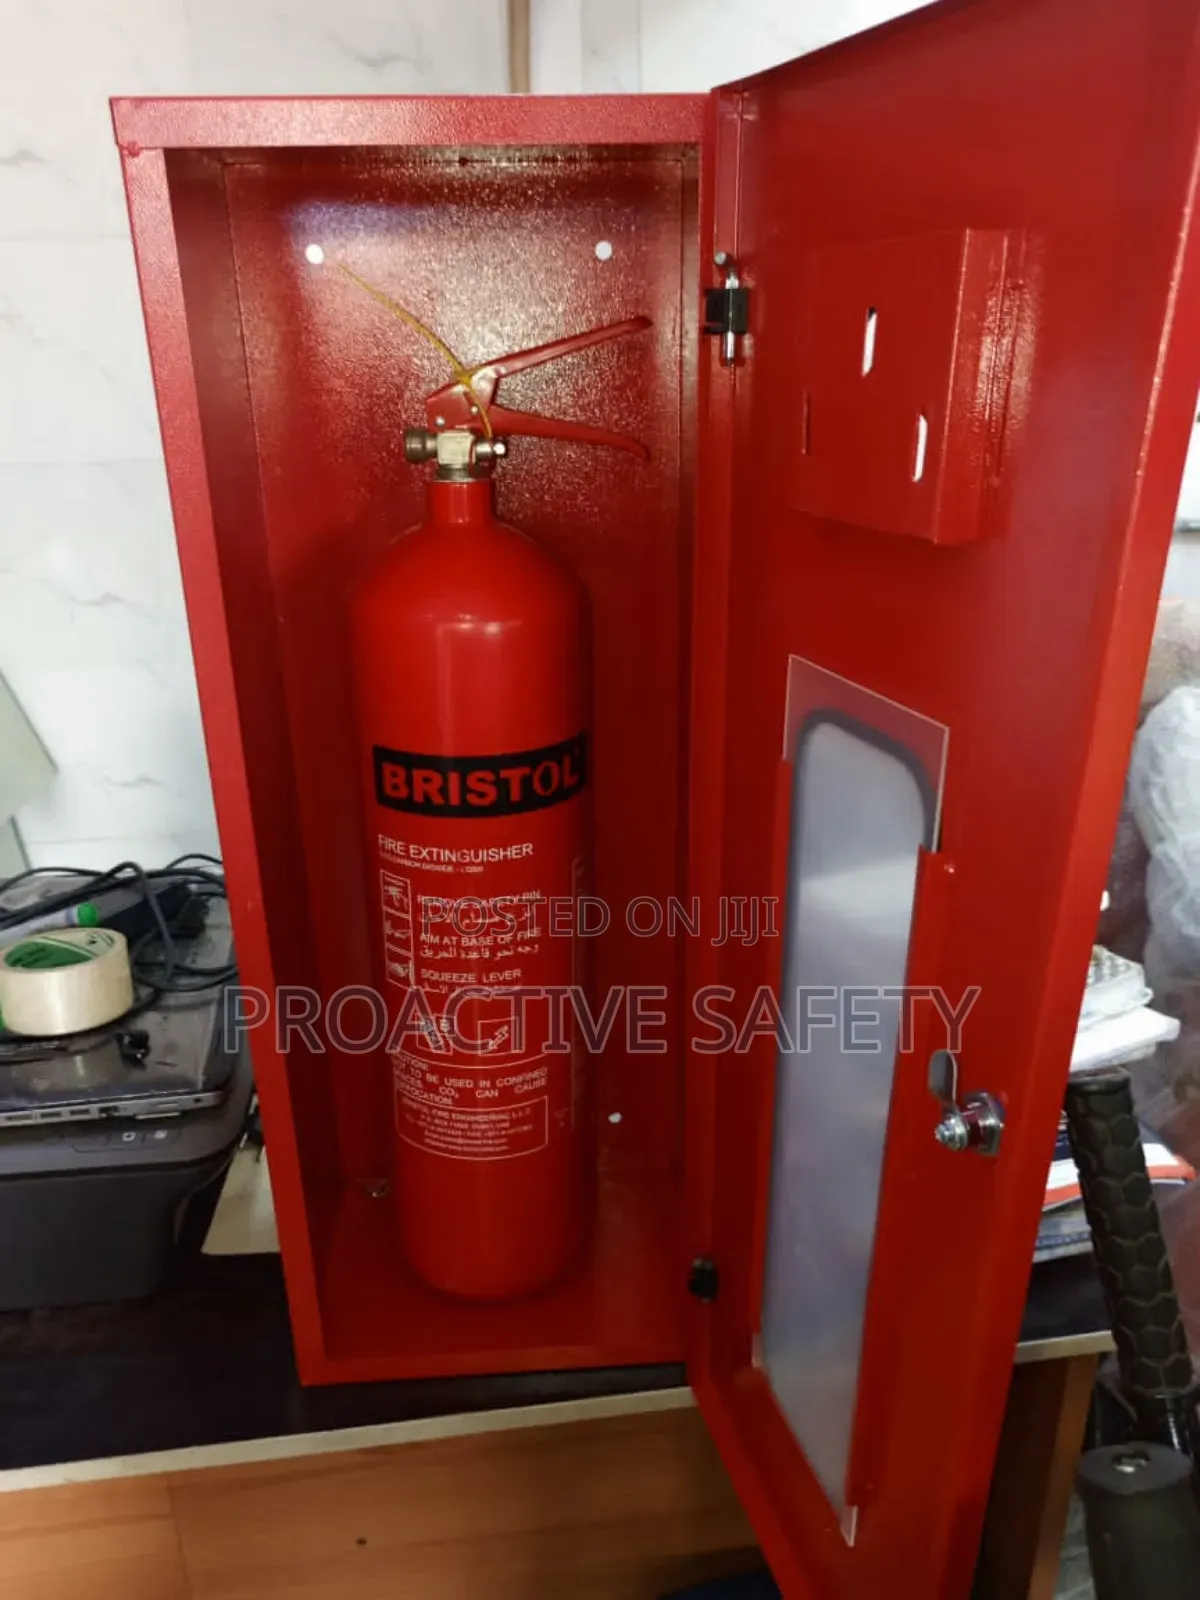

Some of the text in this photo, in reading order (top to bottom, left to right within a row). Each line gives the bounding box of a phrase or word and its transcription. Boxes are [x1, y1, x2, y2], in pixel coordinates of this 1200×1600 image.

[381, 755, 577, 807] BRISTOL
[378, 833, 406, 856] FIRE
[409, 842, 534, 864] EXTINGUISHER
[442, 936, 458, 946] AT
[460, 936, 495, 947] BASE
[497, 934, 514, 944] OF
[420, 968, 523, 983] SQUEEZE LEVER
[444, 1077, 474, 1089] USED
[479, 1077, 491, 1088] IN
[475, 1087, 499, 1099] CAN
[514, 1077, 548, 1094] CAUSE
